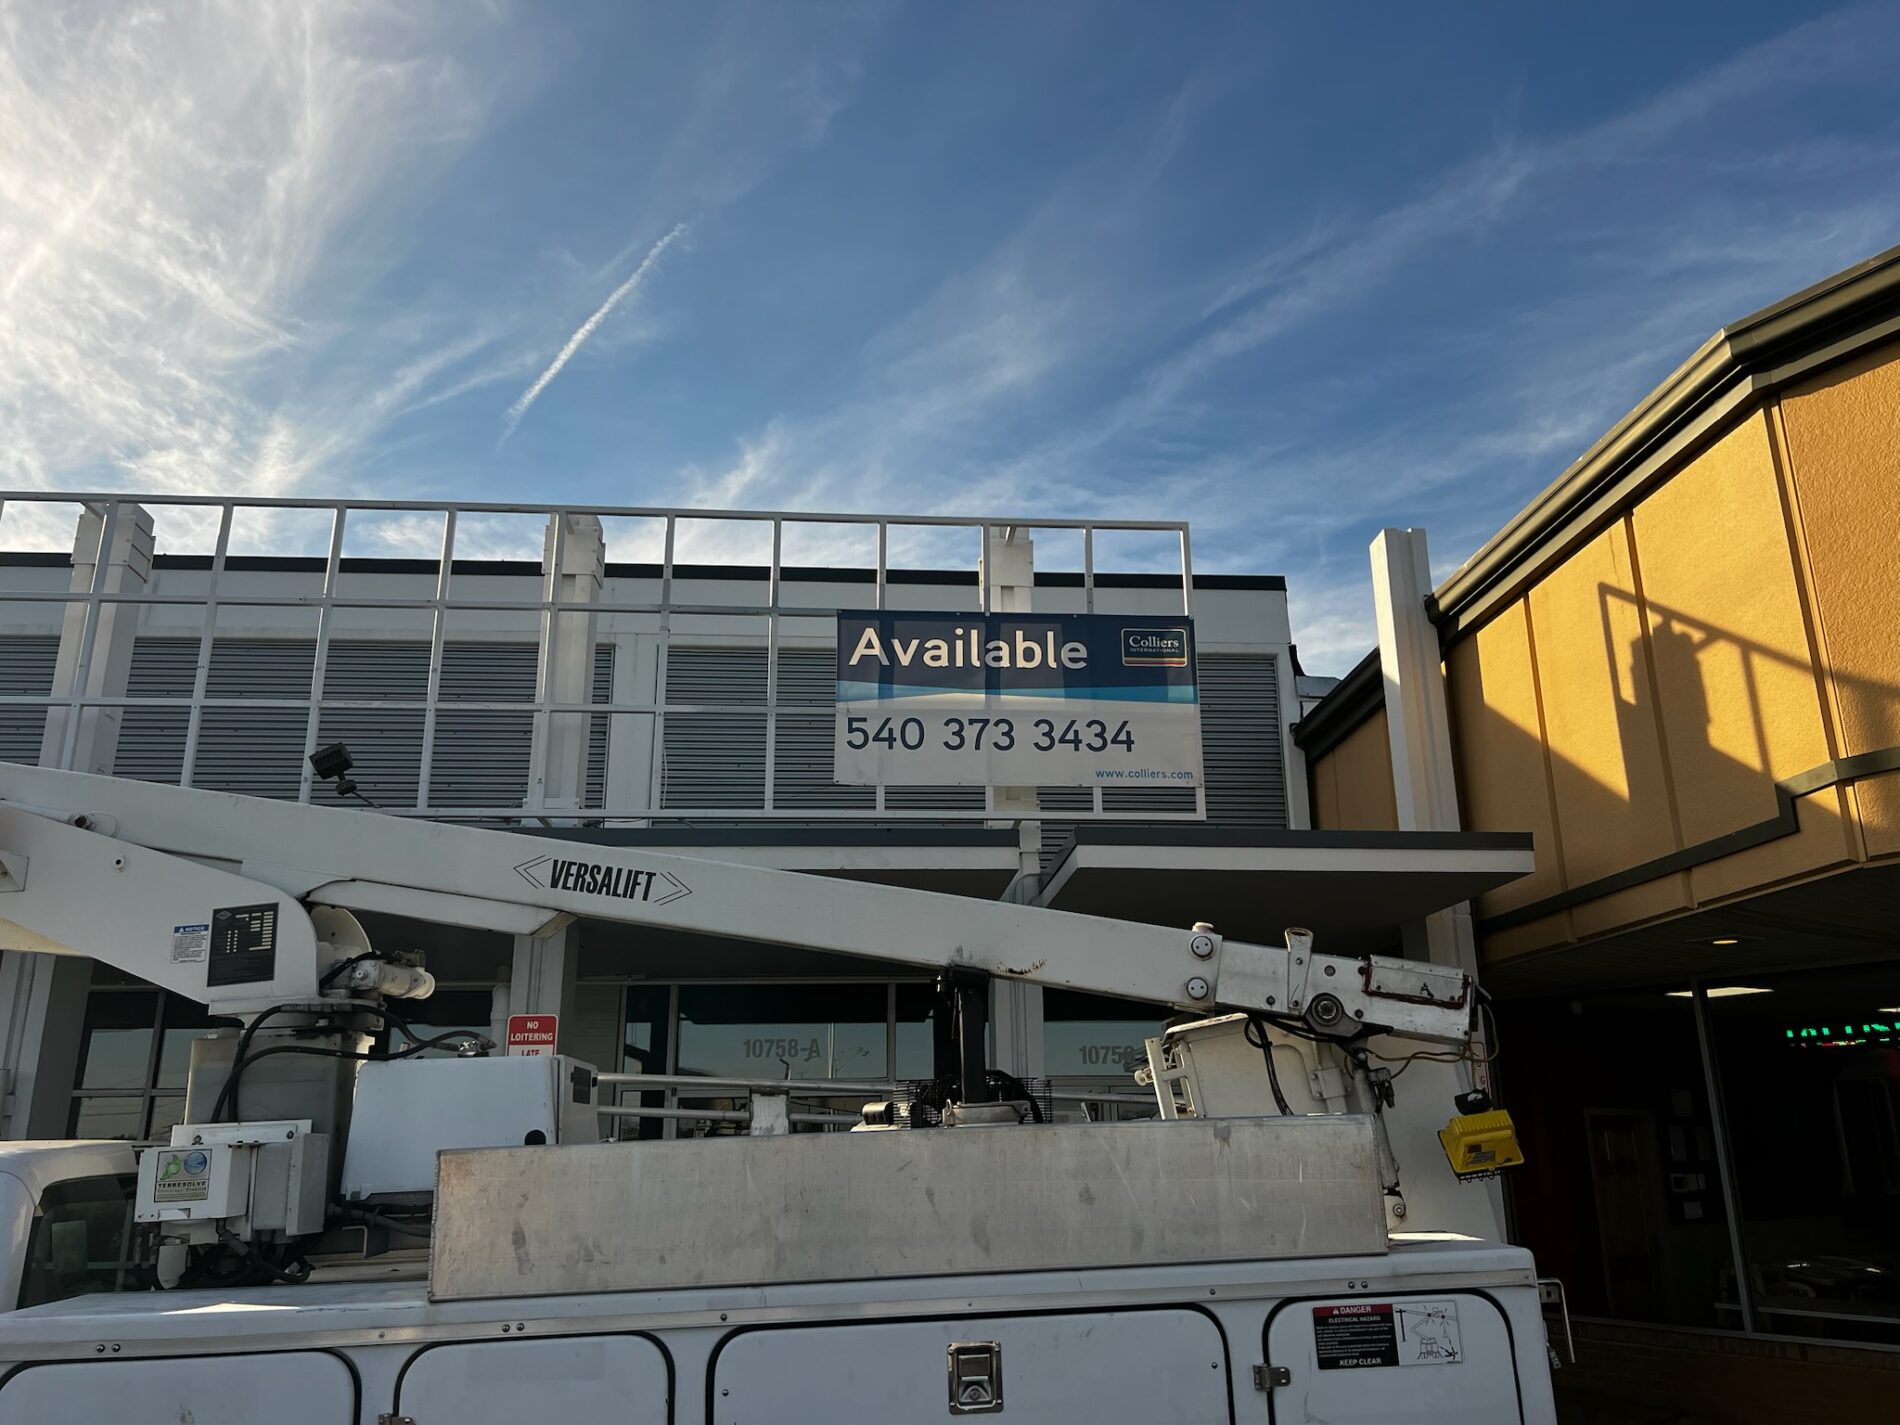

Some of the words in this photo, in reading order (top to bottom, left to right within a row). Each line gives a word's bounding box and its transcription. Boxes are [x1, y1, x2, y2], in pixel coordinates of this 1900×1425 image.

[1128, 635, 1179, 648] Colliers
[848, 627, 1088, 669] Available
[846, 717, 925, 751] 540
[942, 717, 1015, 751] 373
[1033, 718, 1135, 752] 3434
[1095, 768, 1193, 780] www.colliers.com
[550, 859, 656, 901] VERSALIFT
[526, 1021, 539, 1029] NO
[510, 1032, 553, 1041] LOITERING
[743, 1038, 821, 1058] 10758-A
[158, 1181, 206, 1189] TERRESOLVE
[1340, 1305, 1372, 1314] DANGER
[1328, 1316, 1359, 1324] ELECTRICAL
[1339, 1358, 1359, 1367] KEEP
[1359, 1357, 1382, 1366] CLEAR
